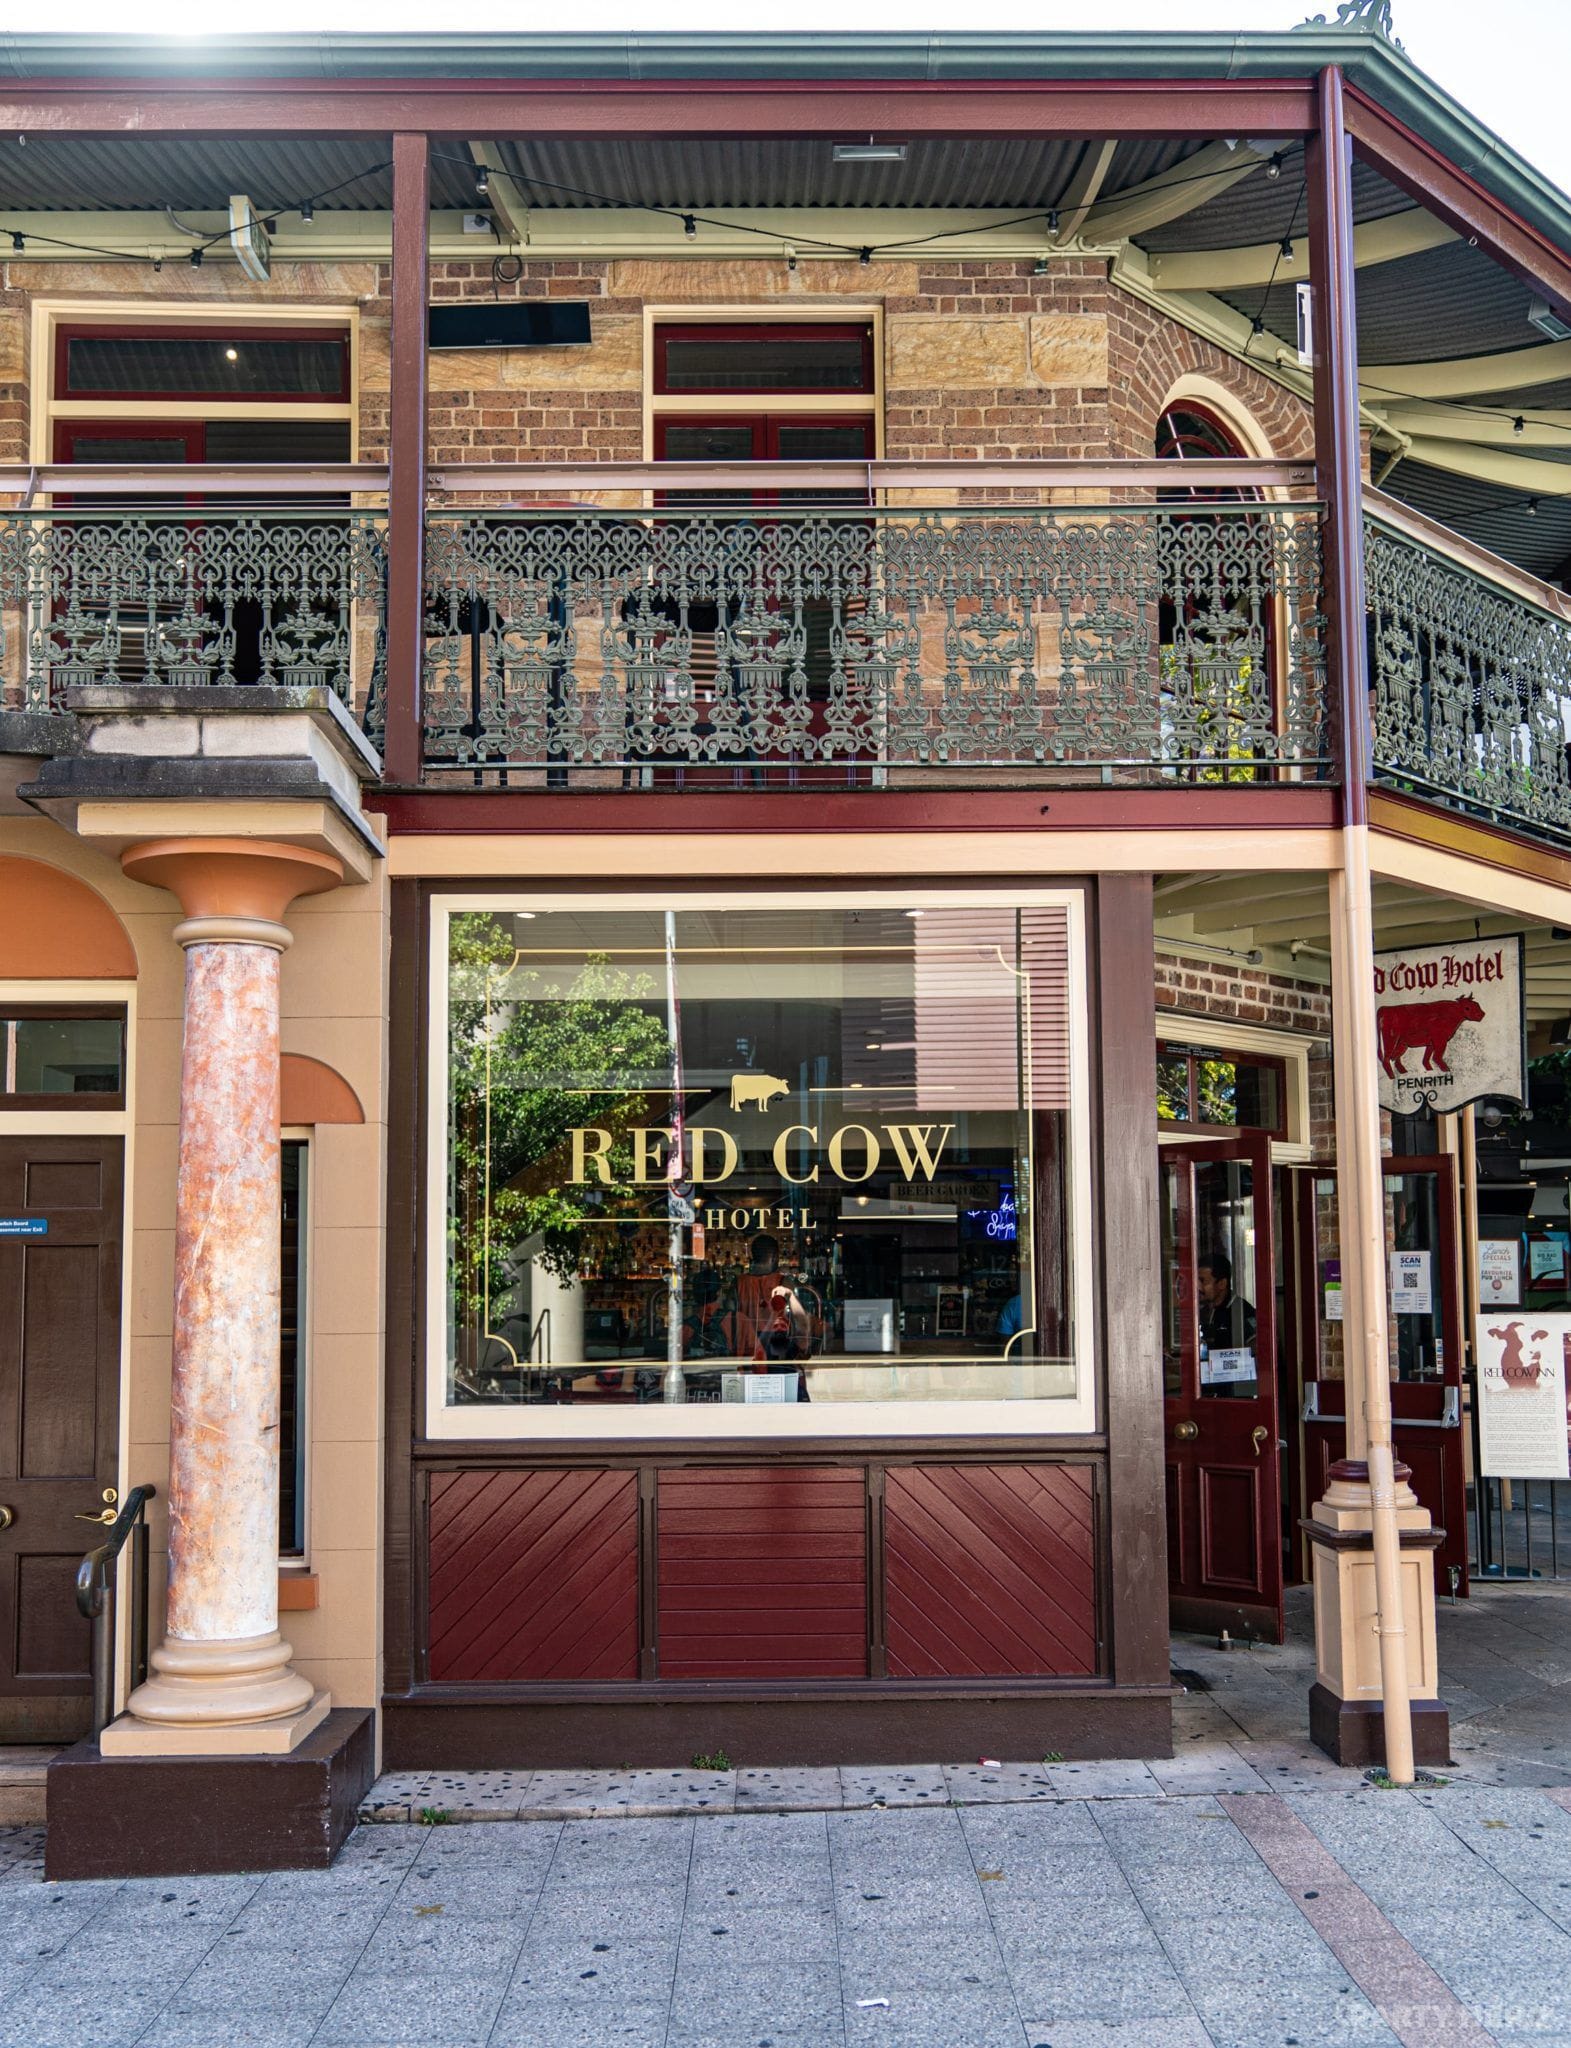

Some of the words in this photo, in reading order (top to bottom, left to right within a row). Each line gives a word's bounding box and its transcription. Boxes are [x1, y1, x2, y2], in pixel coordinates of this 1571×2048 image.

[1390, 960, 1438, 991] Cow
[1441, 950, 1504, 989] Hotel
[1397, 1075, 1454, 1089] PENRITH
[565, 1127, 738, 1184] RED
[773, 1124, 956, 1182] COW
[898, 1185, 934, 1195] BEER
[937, 1184, 989, 1195] GARDEN
[705, 1208, 817, 1230] HOTEL
[1484, 1367, 1504, 1377] RED
[1507, 1367, 1534, 1377] COW
[1536, 1367, 1555, 1377] INN
